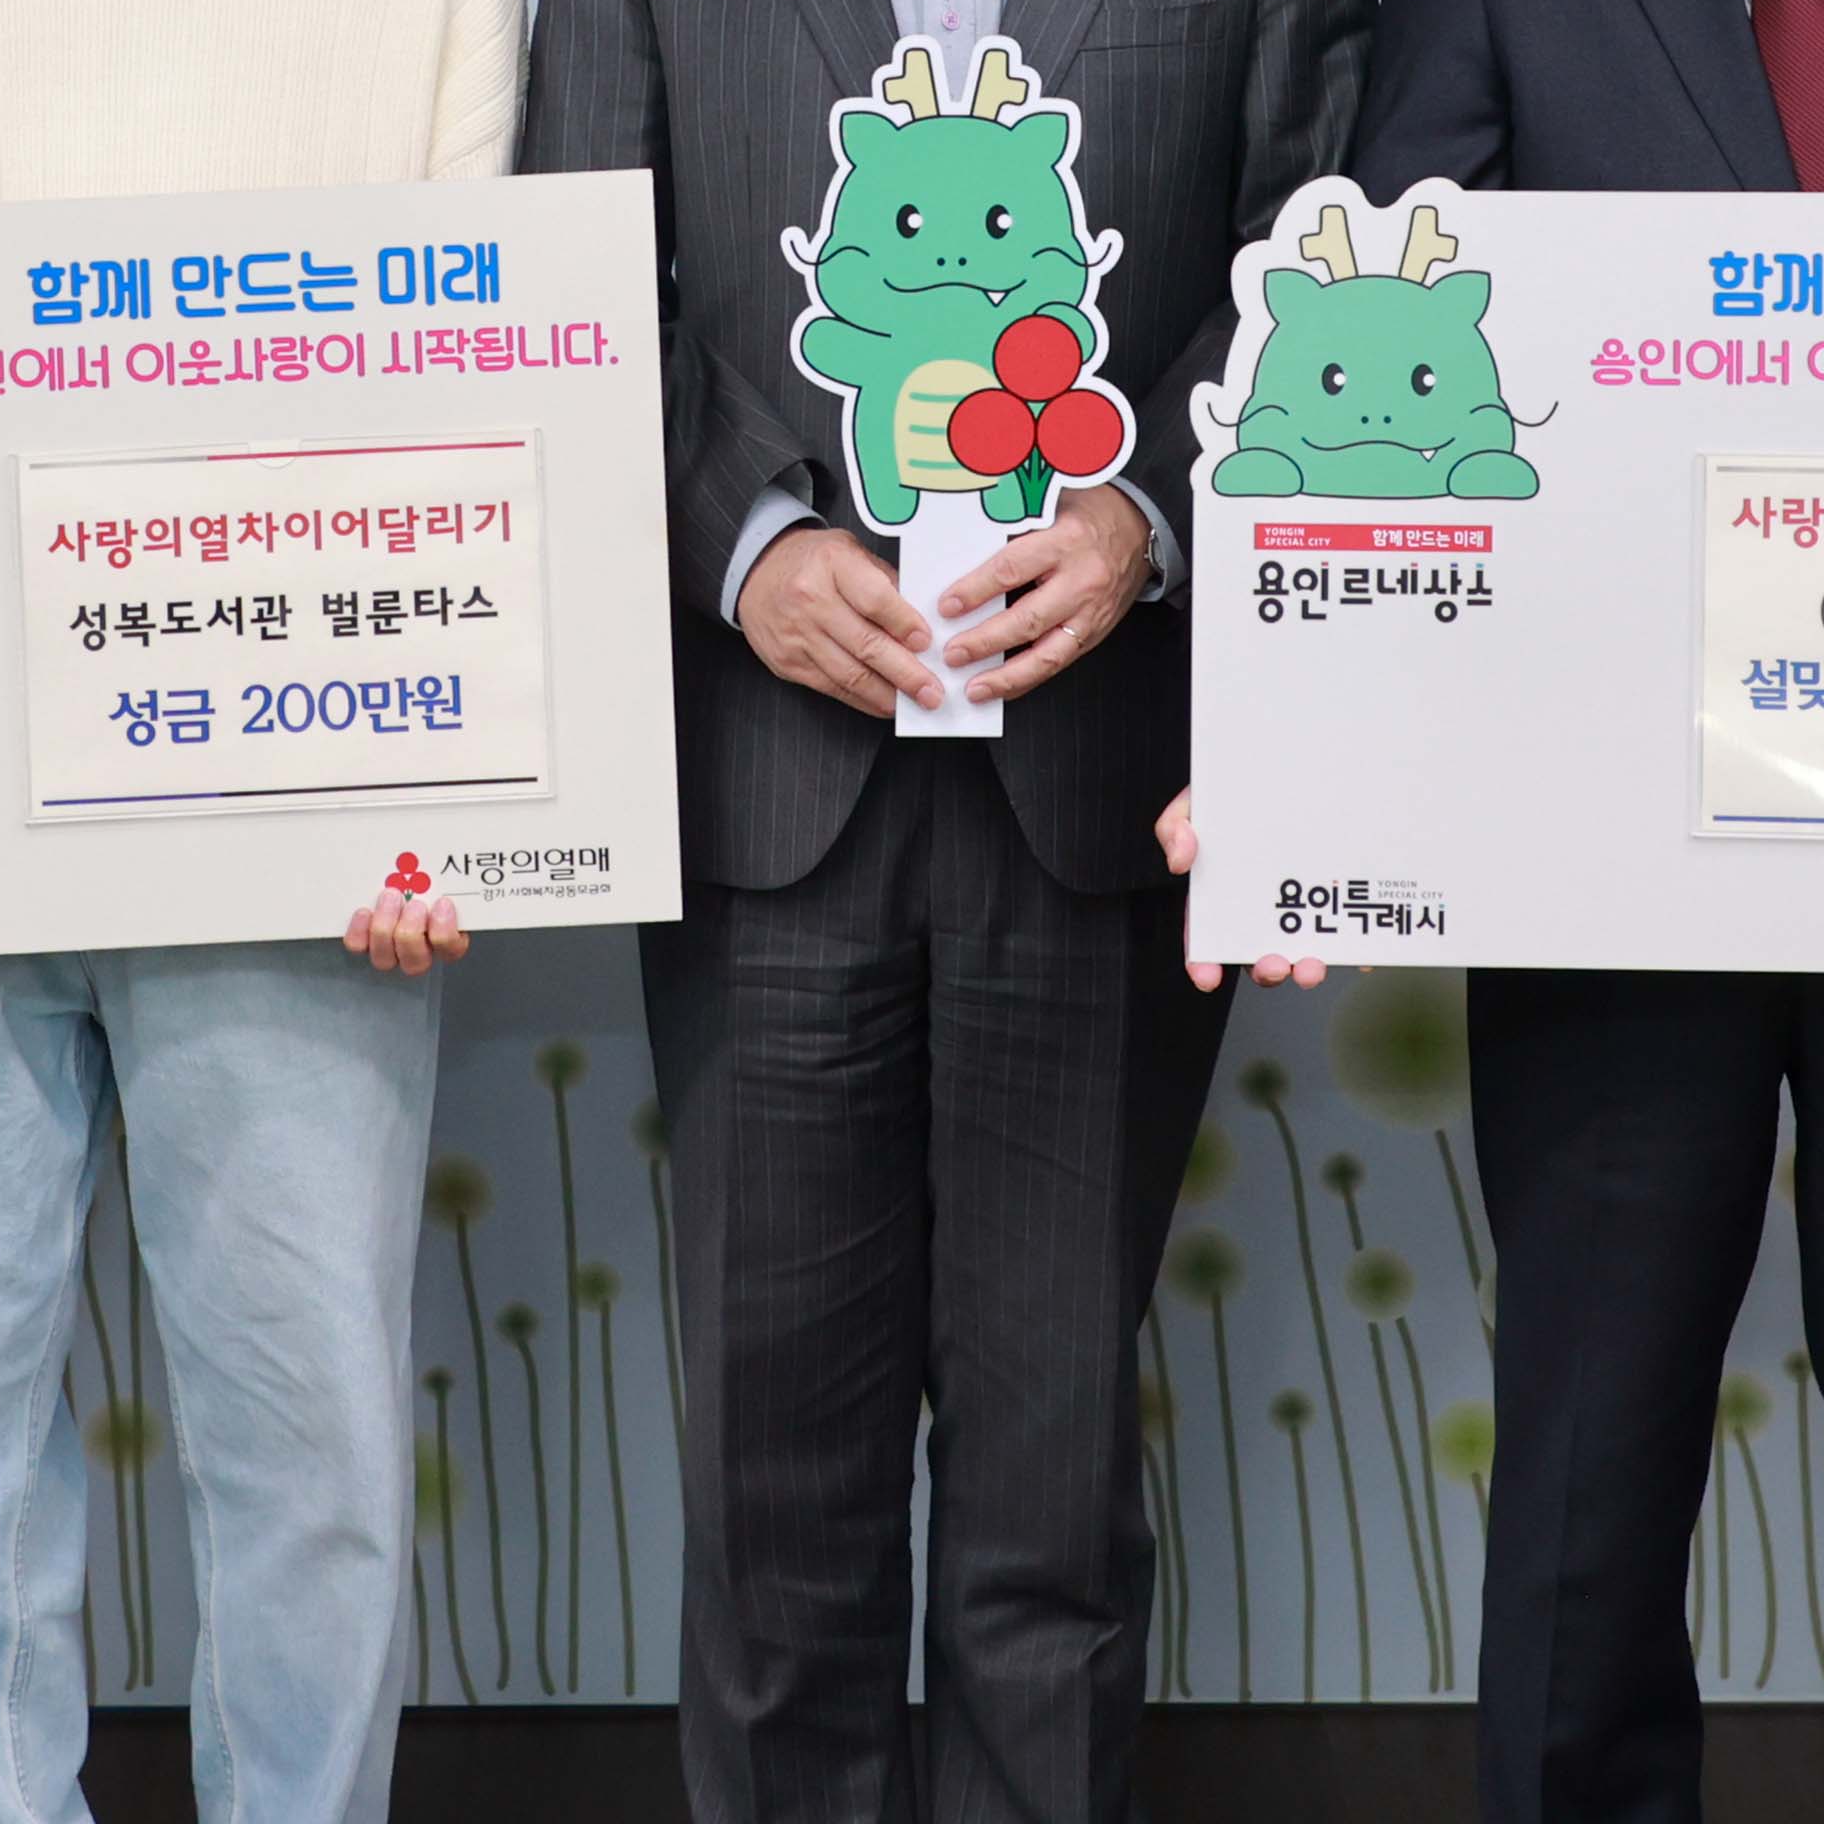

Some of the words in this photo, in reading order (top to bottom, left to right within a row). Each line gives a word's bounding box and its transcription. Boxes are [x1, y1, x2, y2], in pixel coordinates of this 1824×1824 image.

[27, 258, 151, 325] 함께
[172, 251, 358, 318] 만드는
[378, 242, 500, 306] 미래
[126, 333, 365, 386] 이웃사랑이
[382, 322, 618, 374] 시작됩니다.
[1590, 339, 1789, 386] 용인에서
[48, 501, 510, 569] 사랑의열차이어달리기
[1264, 538, 1304, 546] SPECIAL
[1308, 538, 1330, 546] CITY
[1265, 528, 1304, 536] YONGIN
[1373, 529, 1402, 548] 함께
[1406, 530, 1450, 547] 만드는
[1455, 531, 1483, 547] 미래
[70, 595, 292, 651] 성복도서관
[323, 586, 498, 637] 벌룬타스
[109, 690, 215, 746] 성금
[242, 675, 462, 733] 200만원
[441, 848, 609, 885] 사랑의열매
[1275, 879, 1445, 936] 용인특례시
